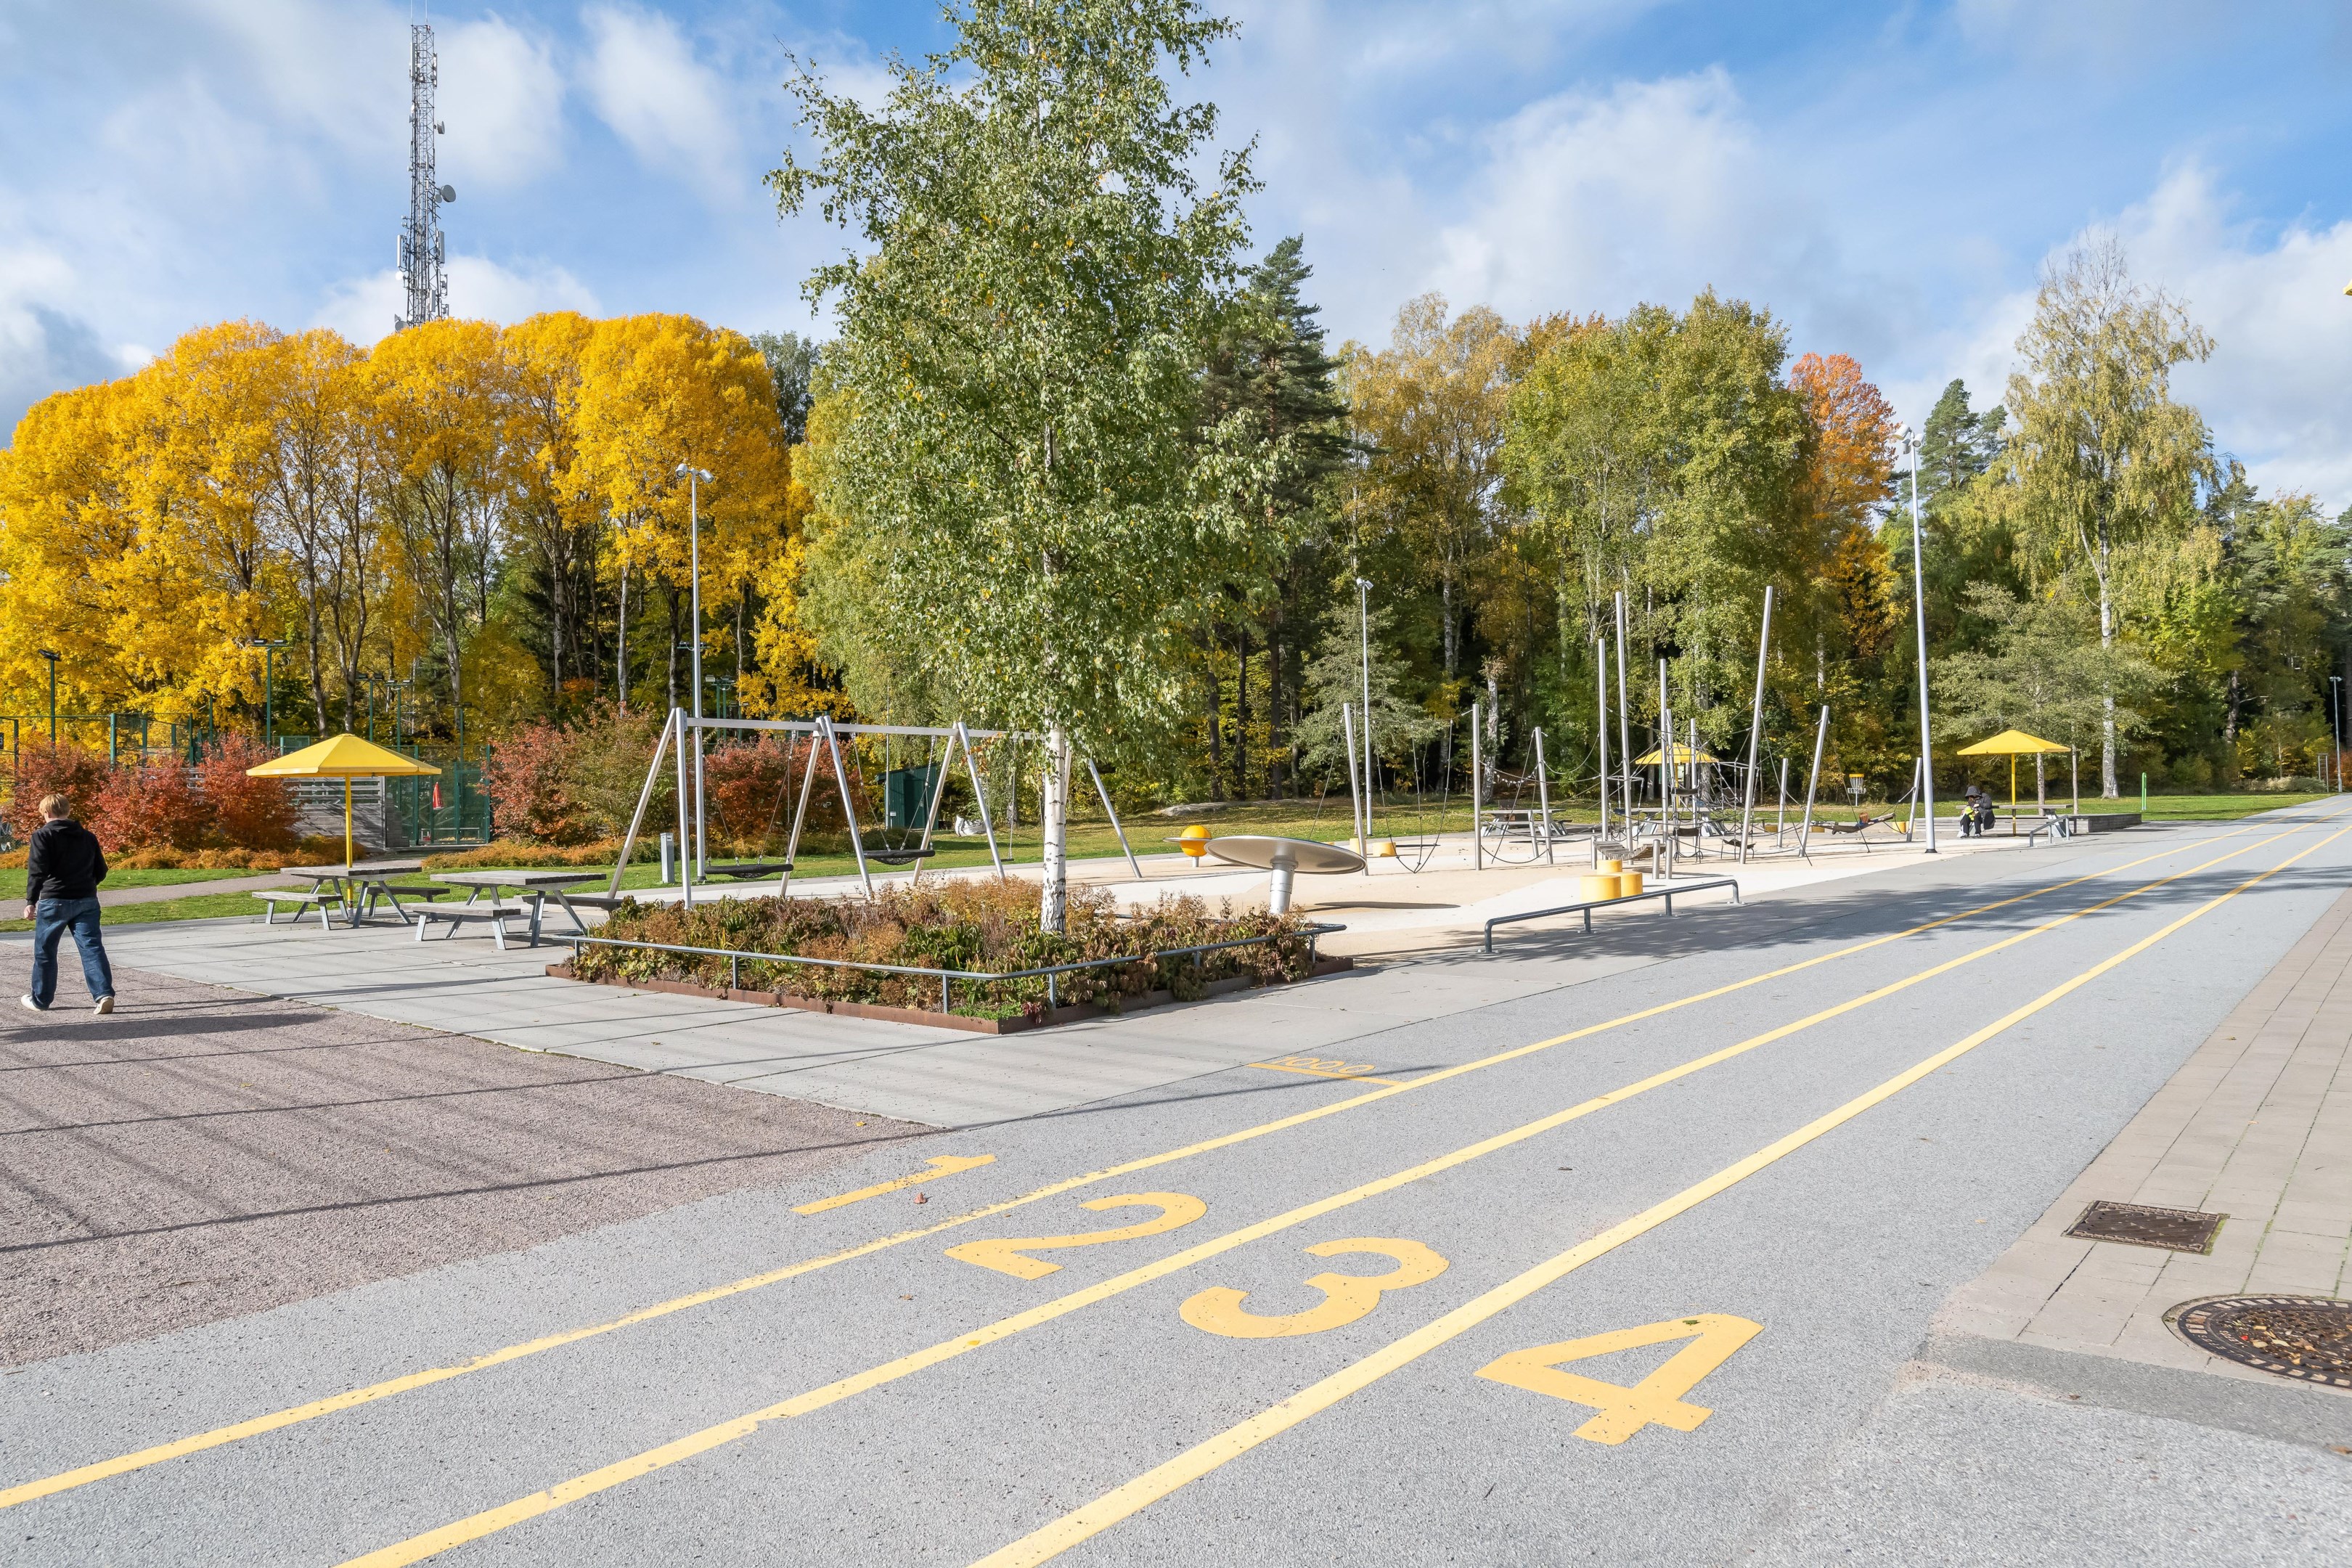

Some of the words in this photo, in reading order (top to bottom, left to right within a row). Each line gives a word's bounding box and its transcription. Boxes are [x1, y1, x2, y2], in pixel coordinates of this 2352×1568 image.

[792, 1153, 995, 1215] 1
[944, 1191, 1206, 1281] 2
[1179, 1237, 1450, 1339] 3
[1474, 1313, 1763, 1445] 4
